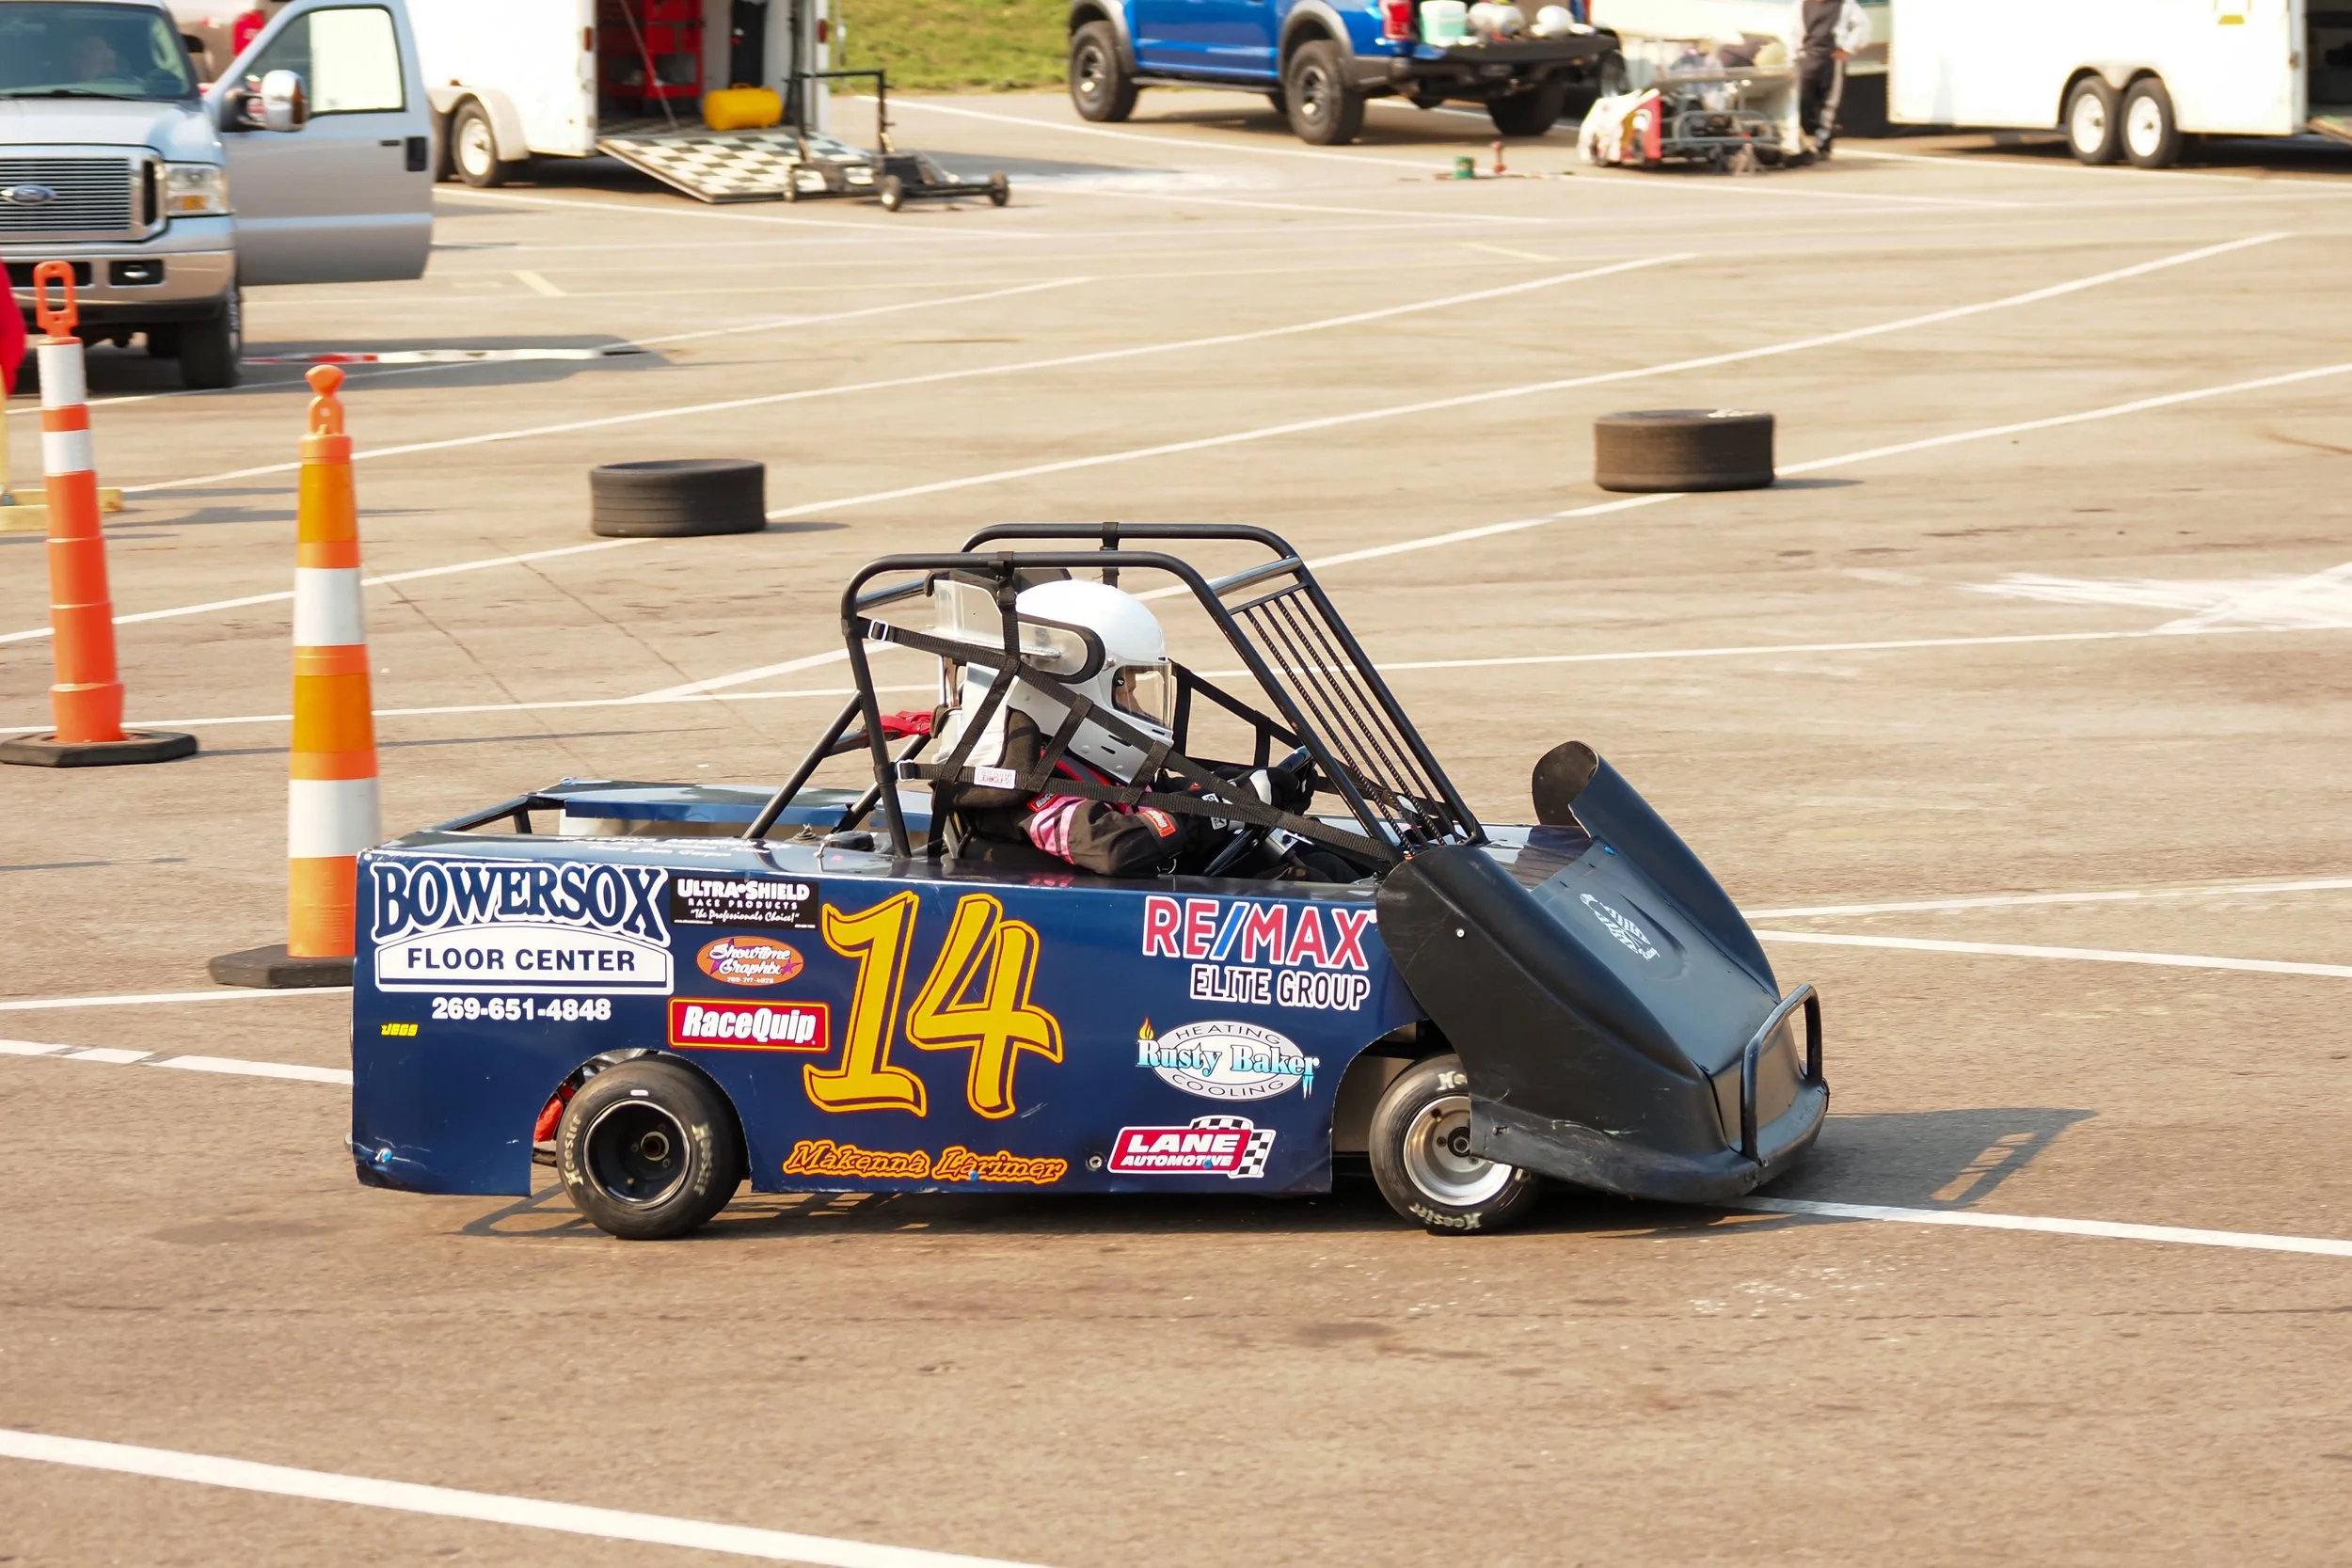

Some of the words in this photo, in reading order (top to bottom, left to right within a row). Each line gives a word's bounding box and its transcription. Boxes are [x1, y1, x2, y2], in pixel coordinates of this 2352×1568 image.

[373, 863, 668, 944] BOWERSOX
[688, 897, 721, 908] RACE
[728, 899, 798, 911] PRODUCTS
[1143, 896, 1370, 969] RE/MAX
[407, 947, 504, 970] FLOOR
[515, 948, 636, 972] CENTER
[1191, 966, 1271, 1002] ELITE
[1278, 972, 1368, 1008] GROUP
[432, 997, 612, 1021] 269-651-4848
[803, 891, 1063, 1118] 14
[381, 1022, 419, 1037] JEGS
[682, 1006, 817, 1043] RaceQuip
[1175, 1024, 1281, 1045] HEATING
[1136, 1039, 1222, 1076] Rusty
[1231, 1044, 1321, 1076] Baker
[1172, 1074, 1284, 1097] COOLING
[1127, 1133, 1241, 1152] LANE
[787, 1142, 929, 1176] Makenna
[934, 1148, 1065, 1182] Larimer
